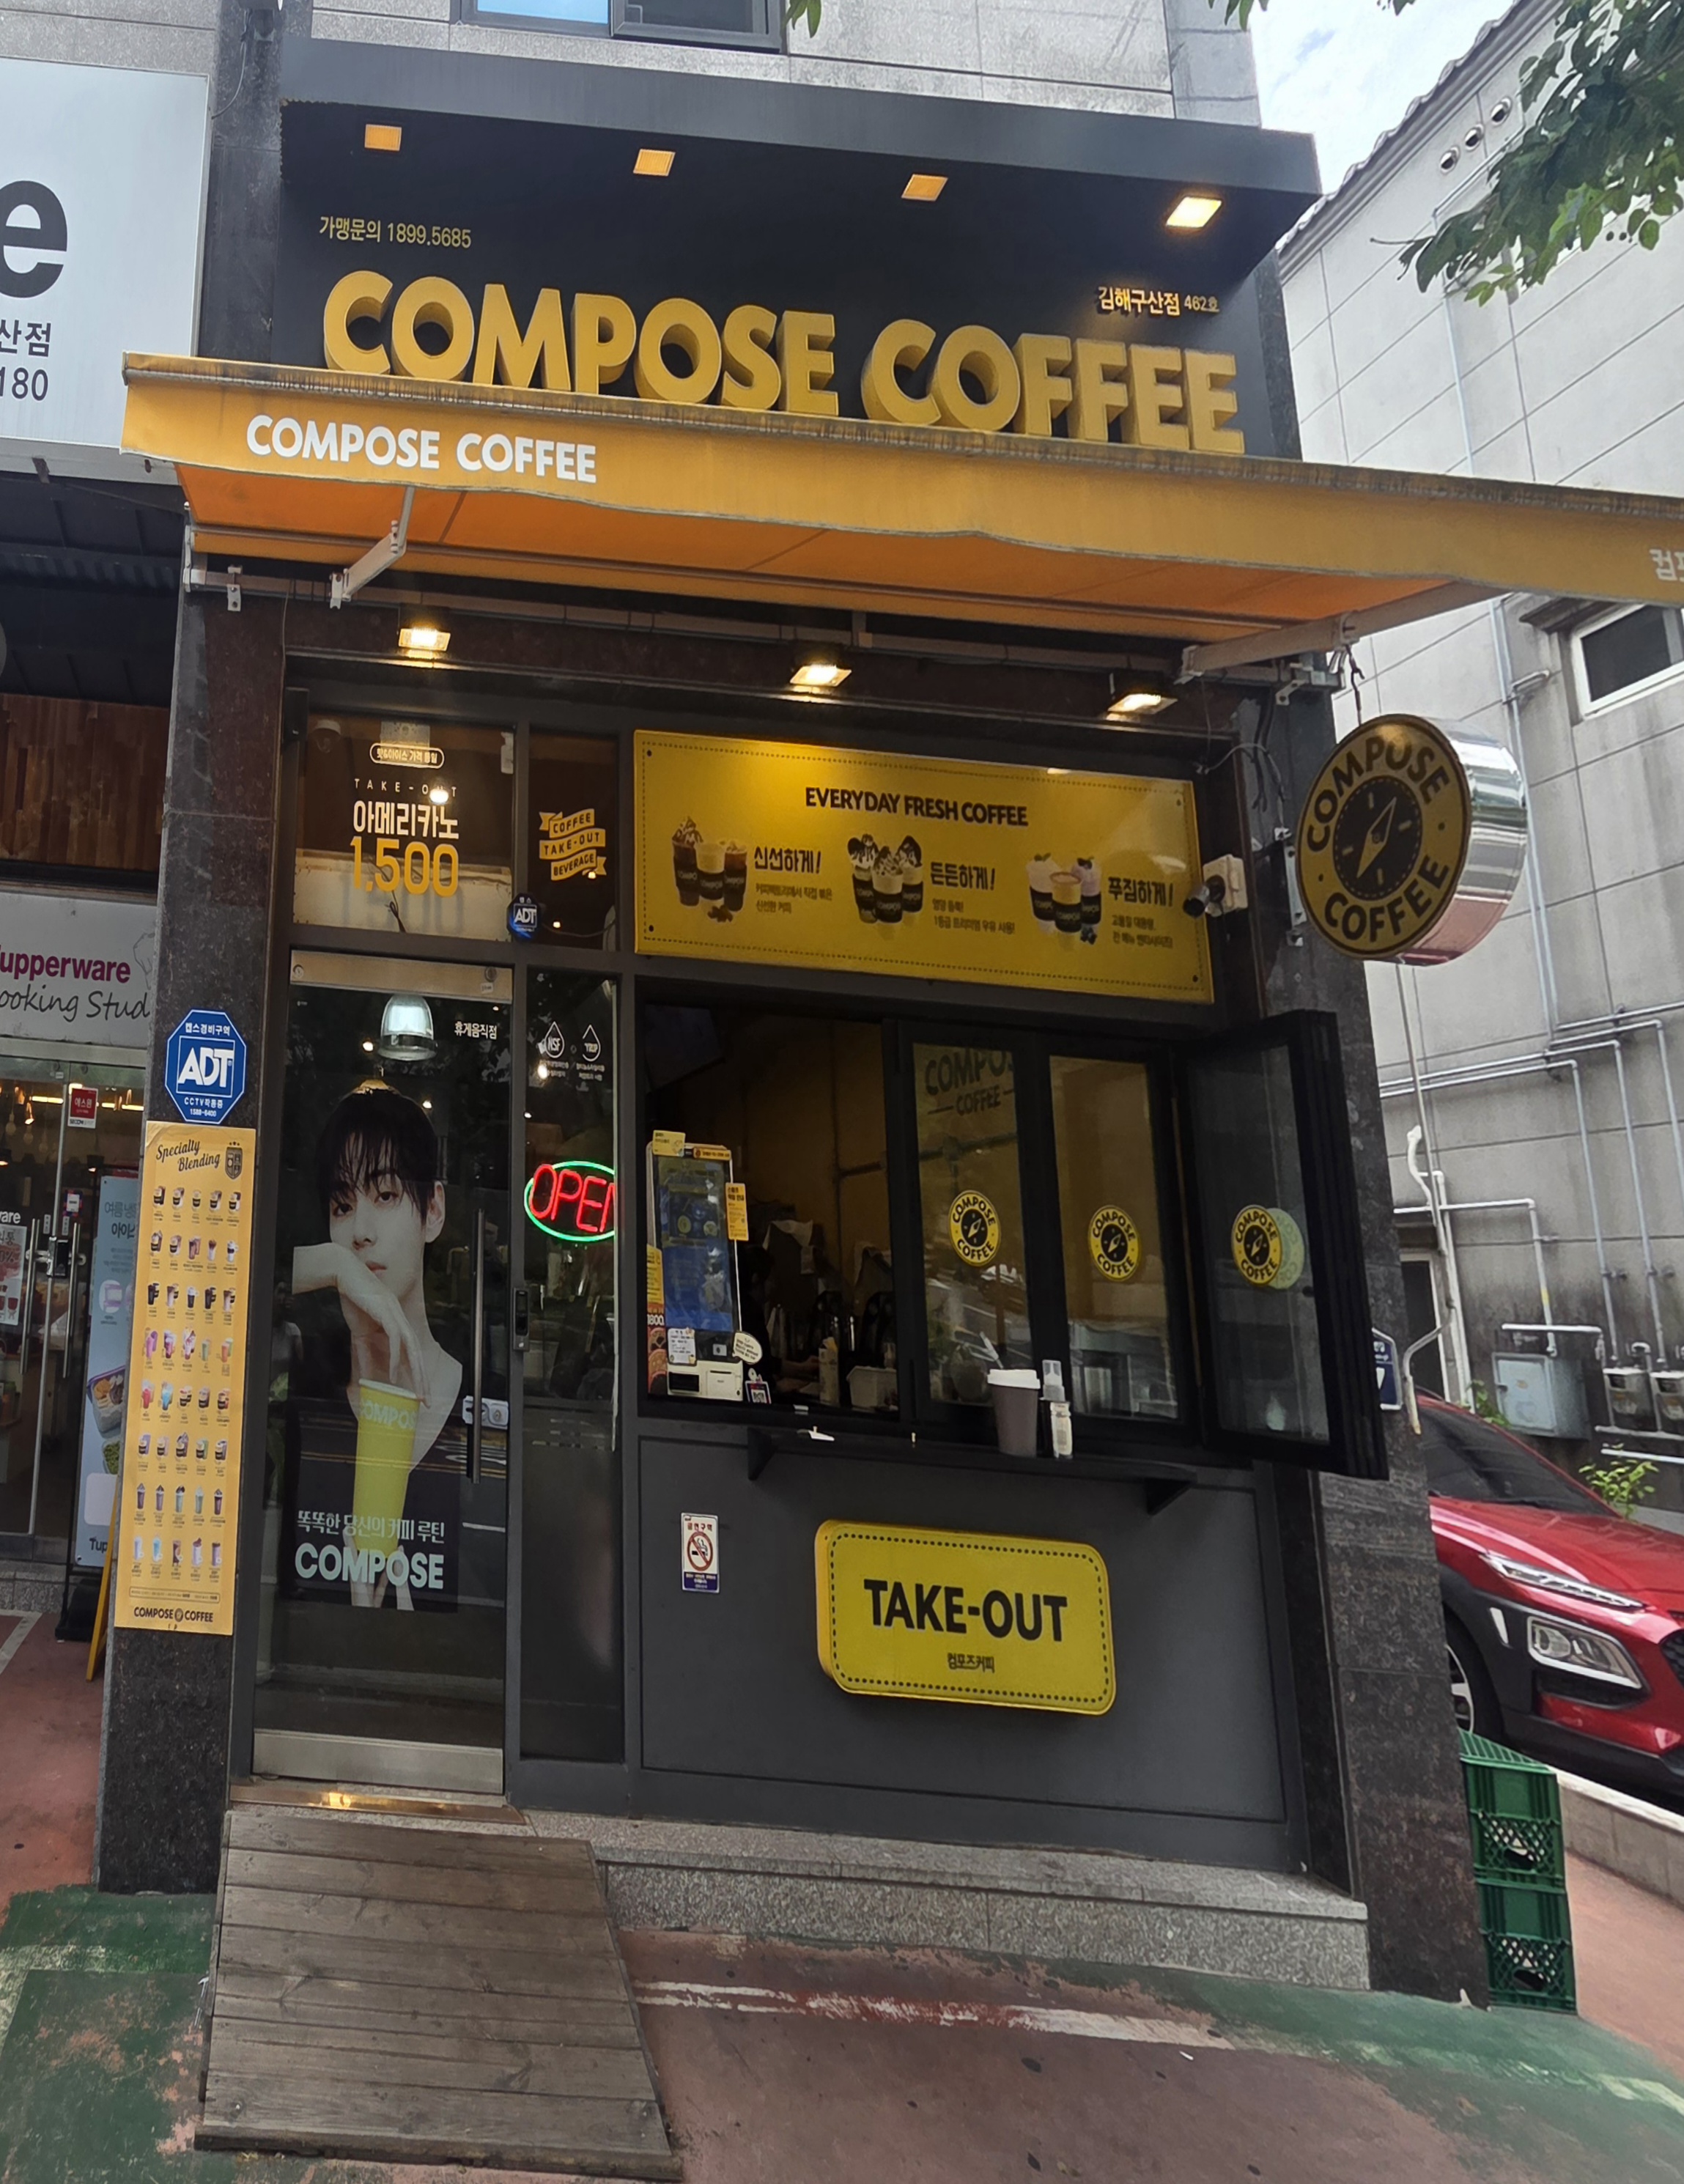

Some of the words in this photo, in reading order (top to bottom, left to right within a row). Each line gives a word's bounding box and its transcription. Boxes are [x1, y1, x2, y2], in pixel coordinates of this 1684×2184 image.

[320, 216, 380, 243] 가맹문의
[388, 223, 471, 248] 1899.5685
[1098, 287, 1180, 316] 김해구산점
[1184, 295, 1219, 312] 462호
[324, 270, 838, 417] COMPOSE
[861, 319, 1244, 454] COFFEE
[247, 415, 439, 469] COMPOSE
[457, 433, 597, 484] COFFEE
[355, 778, 457, 797] TAKE-OT
[1307, 737, 1450, 852] COMPOSE
[353, 800, 459, 839] 아메리카노
[806, 787, 900, 814] EVERYDAY
[904, 795, 958, 821] FRESH
[961, 802, 1028, 826] COFFEE
[553, 813, 591, 833] COFFEE
[553, 854, 594, 876] BEVERAGE
[754, 846, 821, 874] 신선하게!
[931, 862, 995, 890] 든든하게!
[1108, 877, 1173, 907] 푸짐하게!
[1324, 855, 1450, 942] COFFEE
[514, 907, 536, 923] ADT
[0, 951, 130, 983] upperware
[86, 991, 150, 1020] Stud
[178, 1047, 234, 1088] ADT
[925, 1049, 1013, 1096] COMPO
[956, 1085, 1001, 1115] COFFEE
[177, 1154, 221, 1172] Blending
[953, 1196, 996, 1226] COMPOSE
[1093, 1210, 1136, 1242] COMPOSE
[1236, 1210, 1277, 1243] COMPOSE
[957, 1239, 994, 1261] COFFEE
[1096, 1253, 1134, 1277] COFFEE
[1241, 1257, 1277, 1280] COFFEE
[298, 1510, 341, 1535] 똑똑한
[343, 1515, 385, 1539] 당신의
[387, 1518, 415, 1541] 커피
[417, 1520, 445, 1543] 루틴
[295, 1542, 444, 1589] COMPOSE
[134, 1606, 173, 1619] COMPOSE
[185, 1611, 213, 1622] COFFEE
[864, 1579, 1067, 1642] TAKE-OUT
